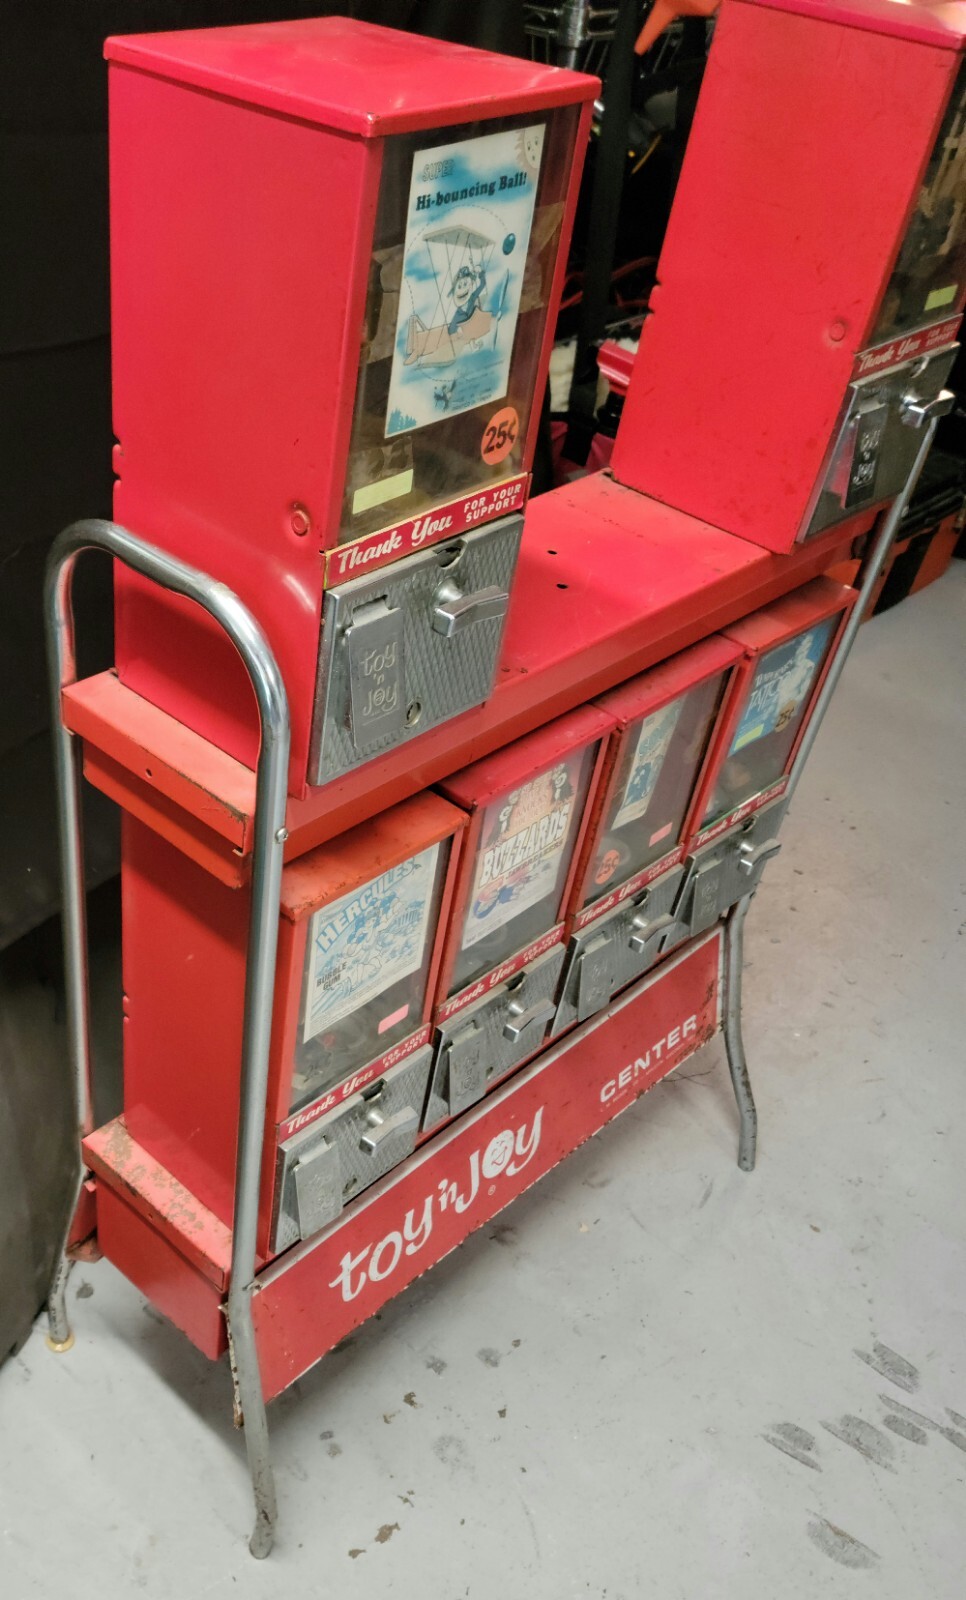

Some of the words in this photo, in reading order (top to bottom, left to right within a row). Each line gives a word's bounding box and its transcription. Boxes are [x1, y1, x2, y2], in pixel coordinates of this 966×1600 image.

[422, 159, 455, 181] SUPER
[416, 181, 496, 211] Hi-bouncing
[498, 172, 528, 190] Ball!
[483, 417, 517, 454] 25¢
[463, 497, 485, 513] FOR
[493, 484, 522, 503] YOUR
[465, 495, 517, 523] SUPPORT
[338, 531, 403, 574] Thank
[411, 515, 453, 547] You
[360, 641, 398, 676] toy
[479, 803, 571, 888] BUZZARDS
[315, 856, 418, 953] HERCULES
[579, 896, 615, 926] Thank
[619, 879, 642, 901] You
[316, 961, 347, 987] BUBBLE
[323, 973, 341, 990] GUM
[445, 983, 485, 1015] Thank
[489, 963, 516, 987] You
[404, 1030, 427, 1048] YOUR
[286, 1094, 336, 1133] Thank
[342, 1069, 375, 1096] You
[328, 1194, 434, 1302] toy
[600, 1014, 697, 1103] CENTER
